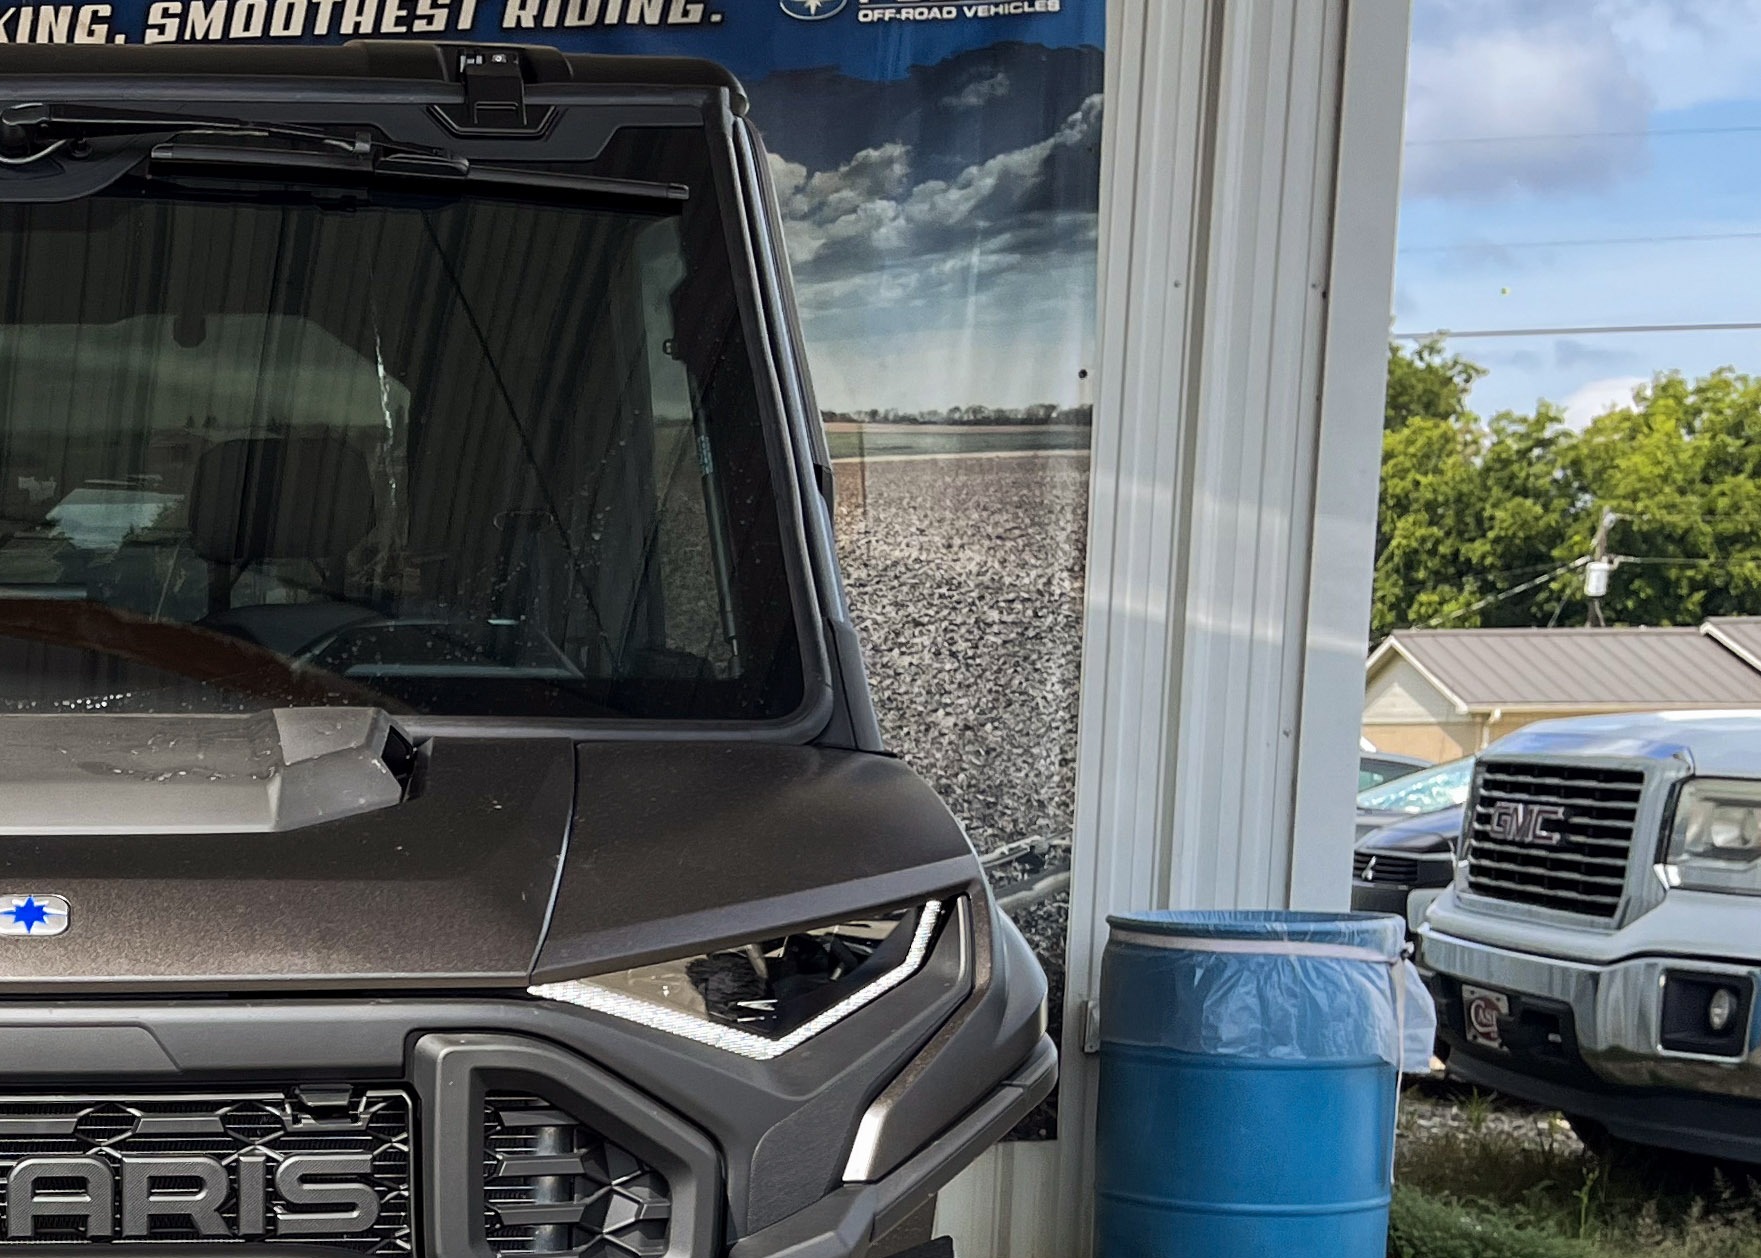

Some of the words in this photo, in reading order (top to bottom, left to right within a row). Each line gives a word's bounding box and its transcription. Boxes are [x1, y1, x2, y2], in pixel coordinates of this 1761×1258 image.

[144, 0, 477, 44] SMOOTHEST
[502, 0, 723, 28] RIDING.
[858, 7, 957, 22] OFF-ROAD
[963, 0, 1060, 18] VEHICLES
[1489, 801, 1565, 846] GMC
